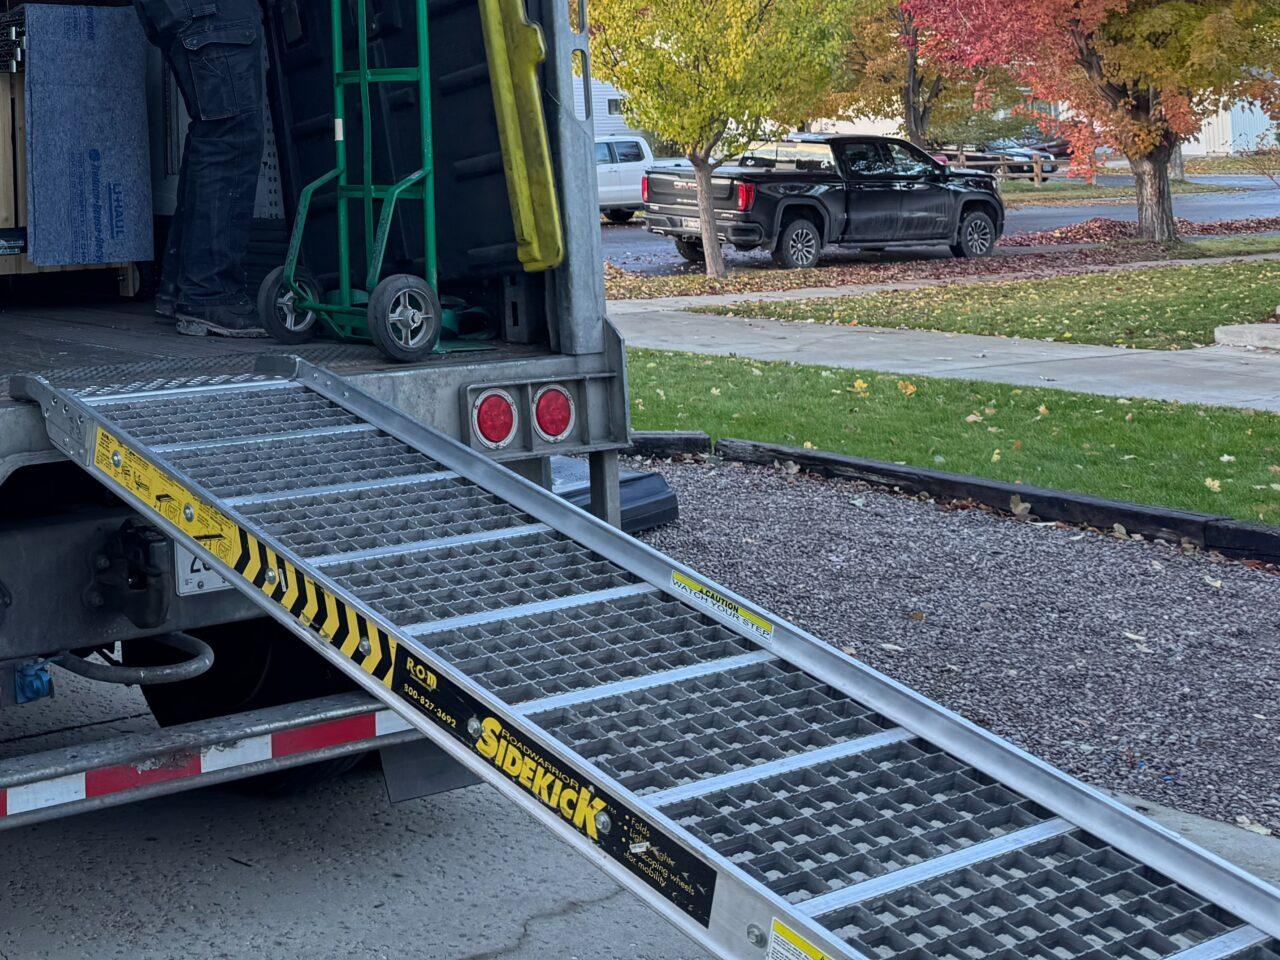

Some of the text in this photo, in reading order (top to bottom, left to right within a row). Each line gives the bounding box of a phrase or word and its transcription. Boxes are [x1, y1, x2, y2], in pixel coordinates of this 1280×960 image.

[672, 580, 770, 637] WATCH YOUR STEP
[703, 589, 739, 614] CAUTION
[475, 716, 607, 841] SIDEKICK
[501, 728, 580, 791] ROADWARRIOR
[631, 817, 650, 838] Folds
[638, 861, 667, 887] mobility
